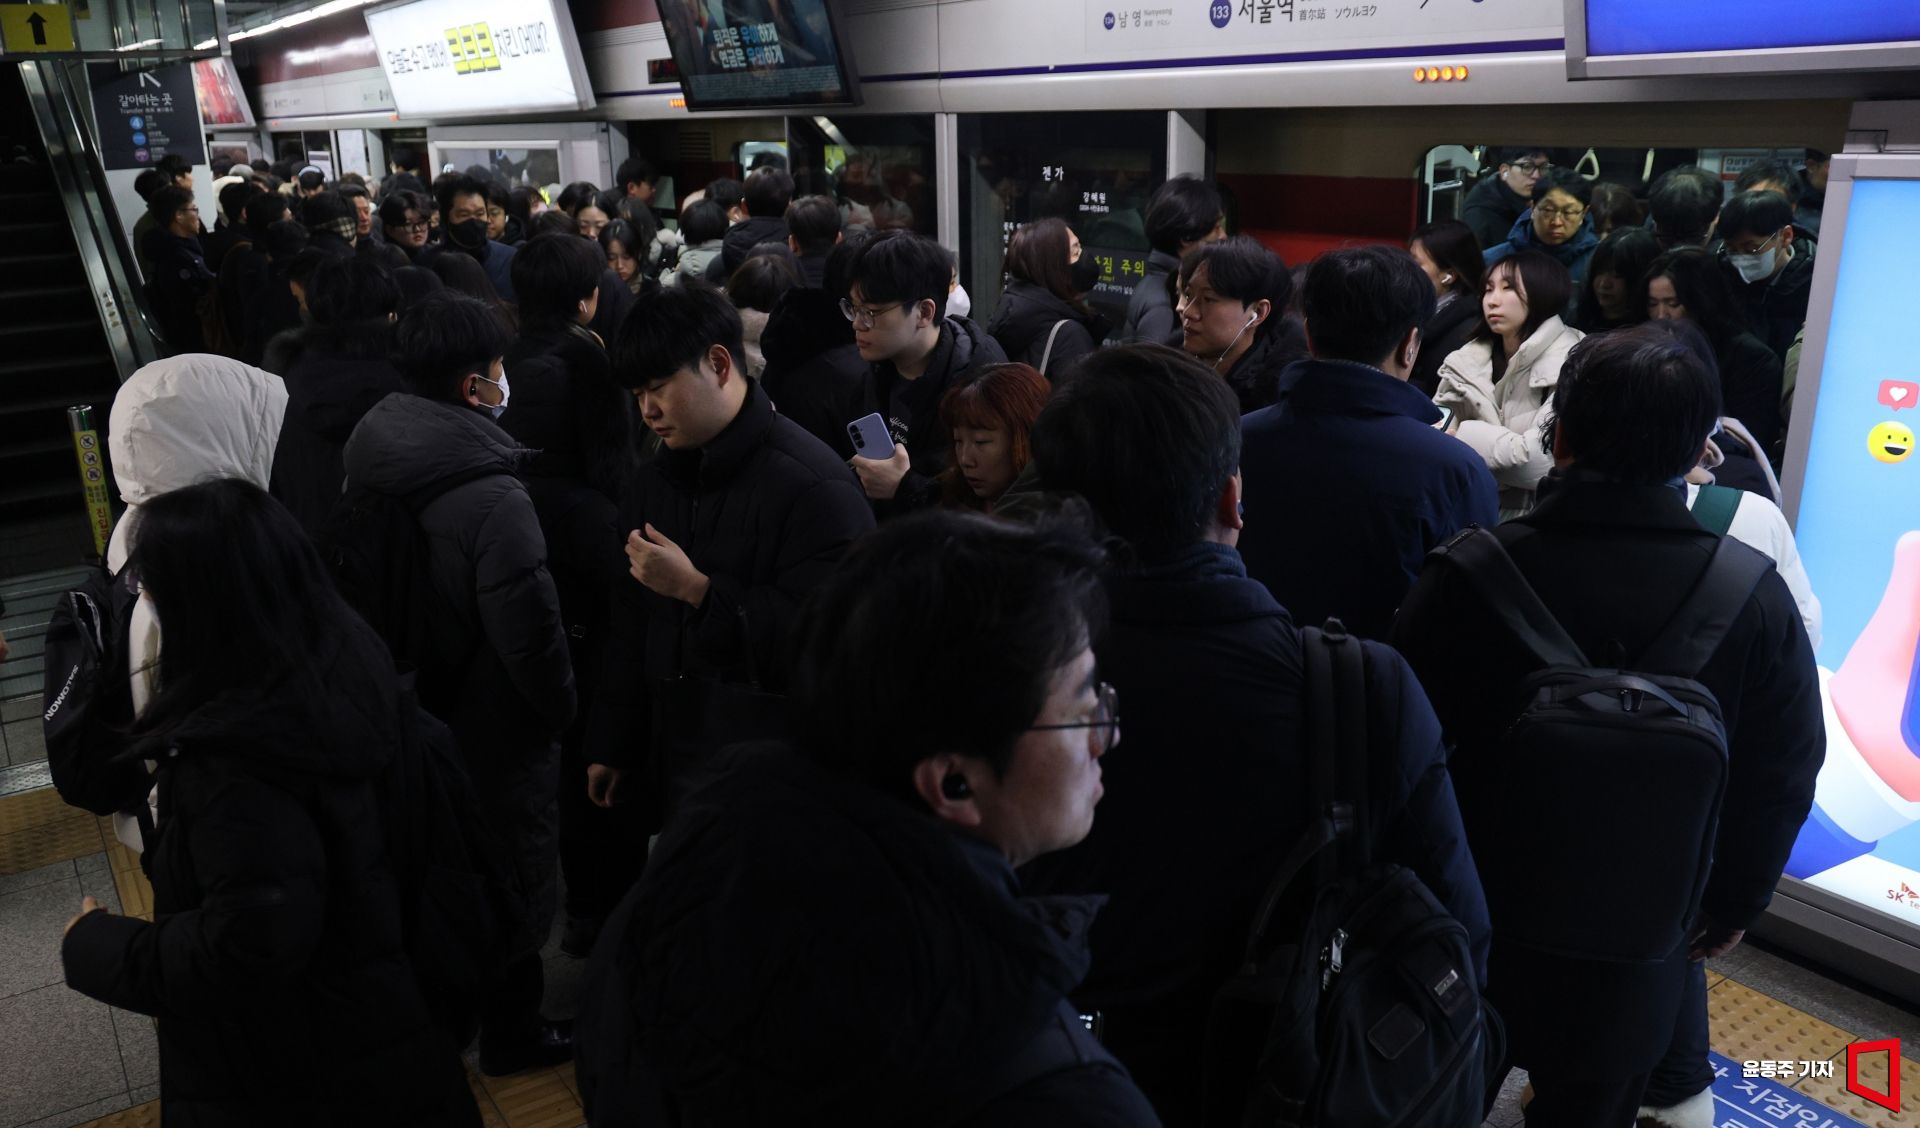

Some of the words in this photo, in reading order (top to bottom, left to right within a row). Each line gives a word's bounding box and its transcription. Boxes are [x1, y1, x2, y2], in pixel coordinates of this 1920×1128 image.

[1212, 5, 1230, 20] 133
[1335, 5, 1377, 19] ソウルヨク
[118, 94, 160, 107] 갈아타는
[161, 92, 173, 106] 곳
[1120, 259, 1145, 278] 주의
[1886, 889, 1905, 904] SK
